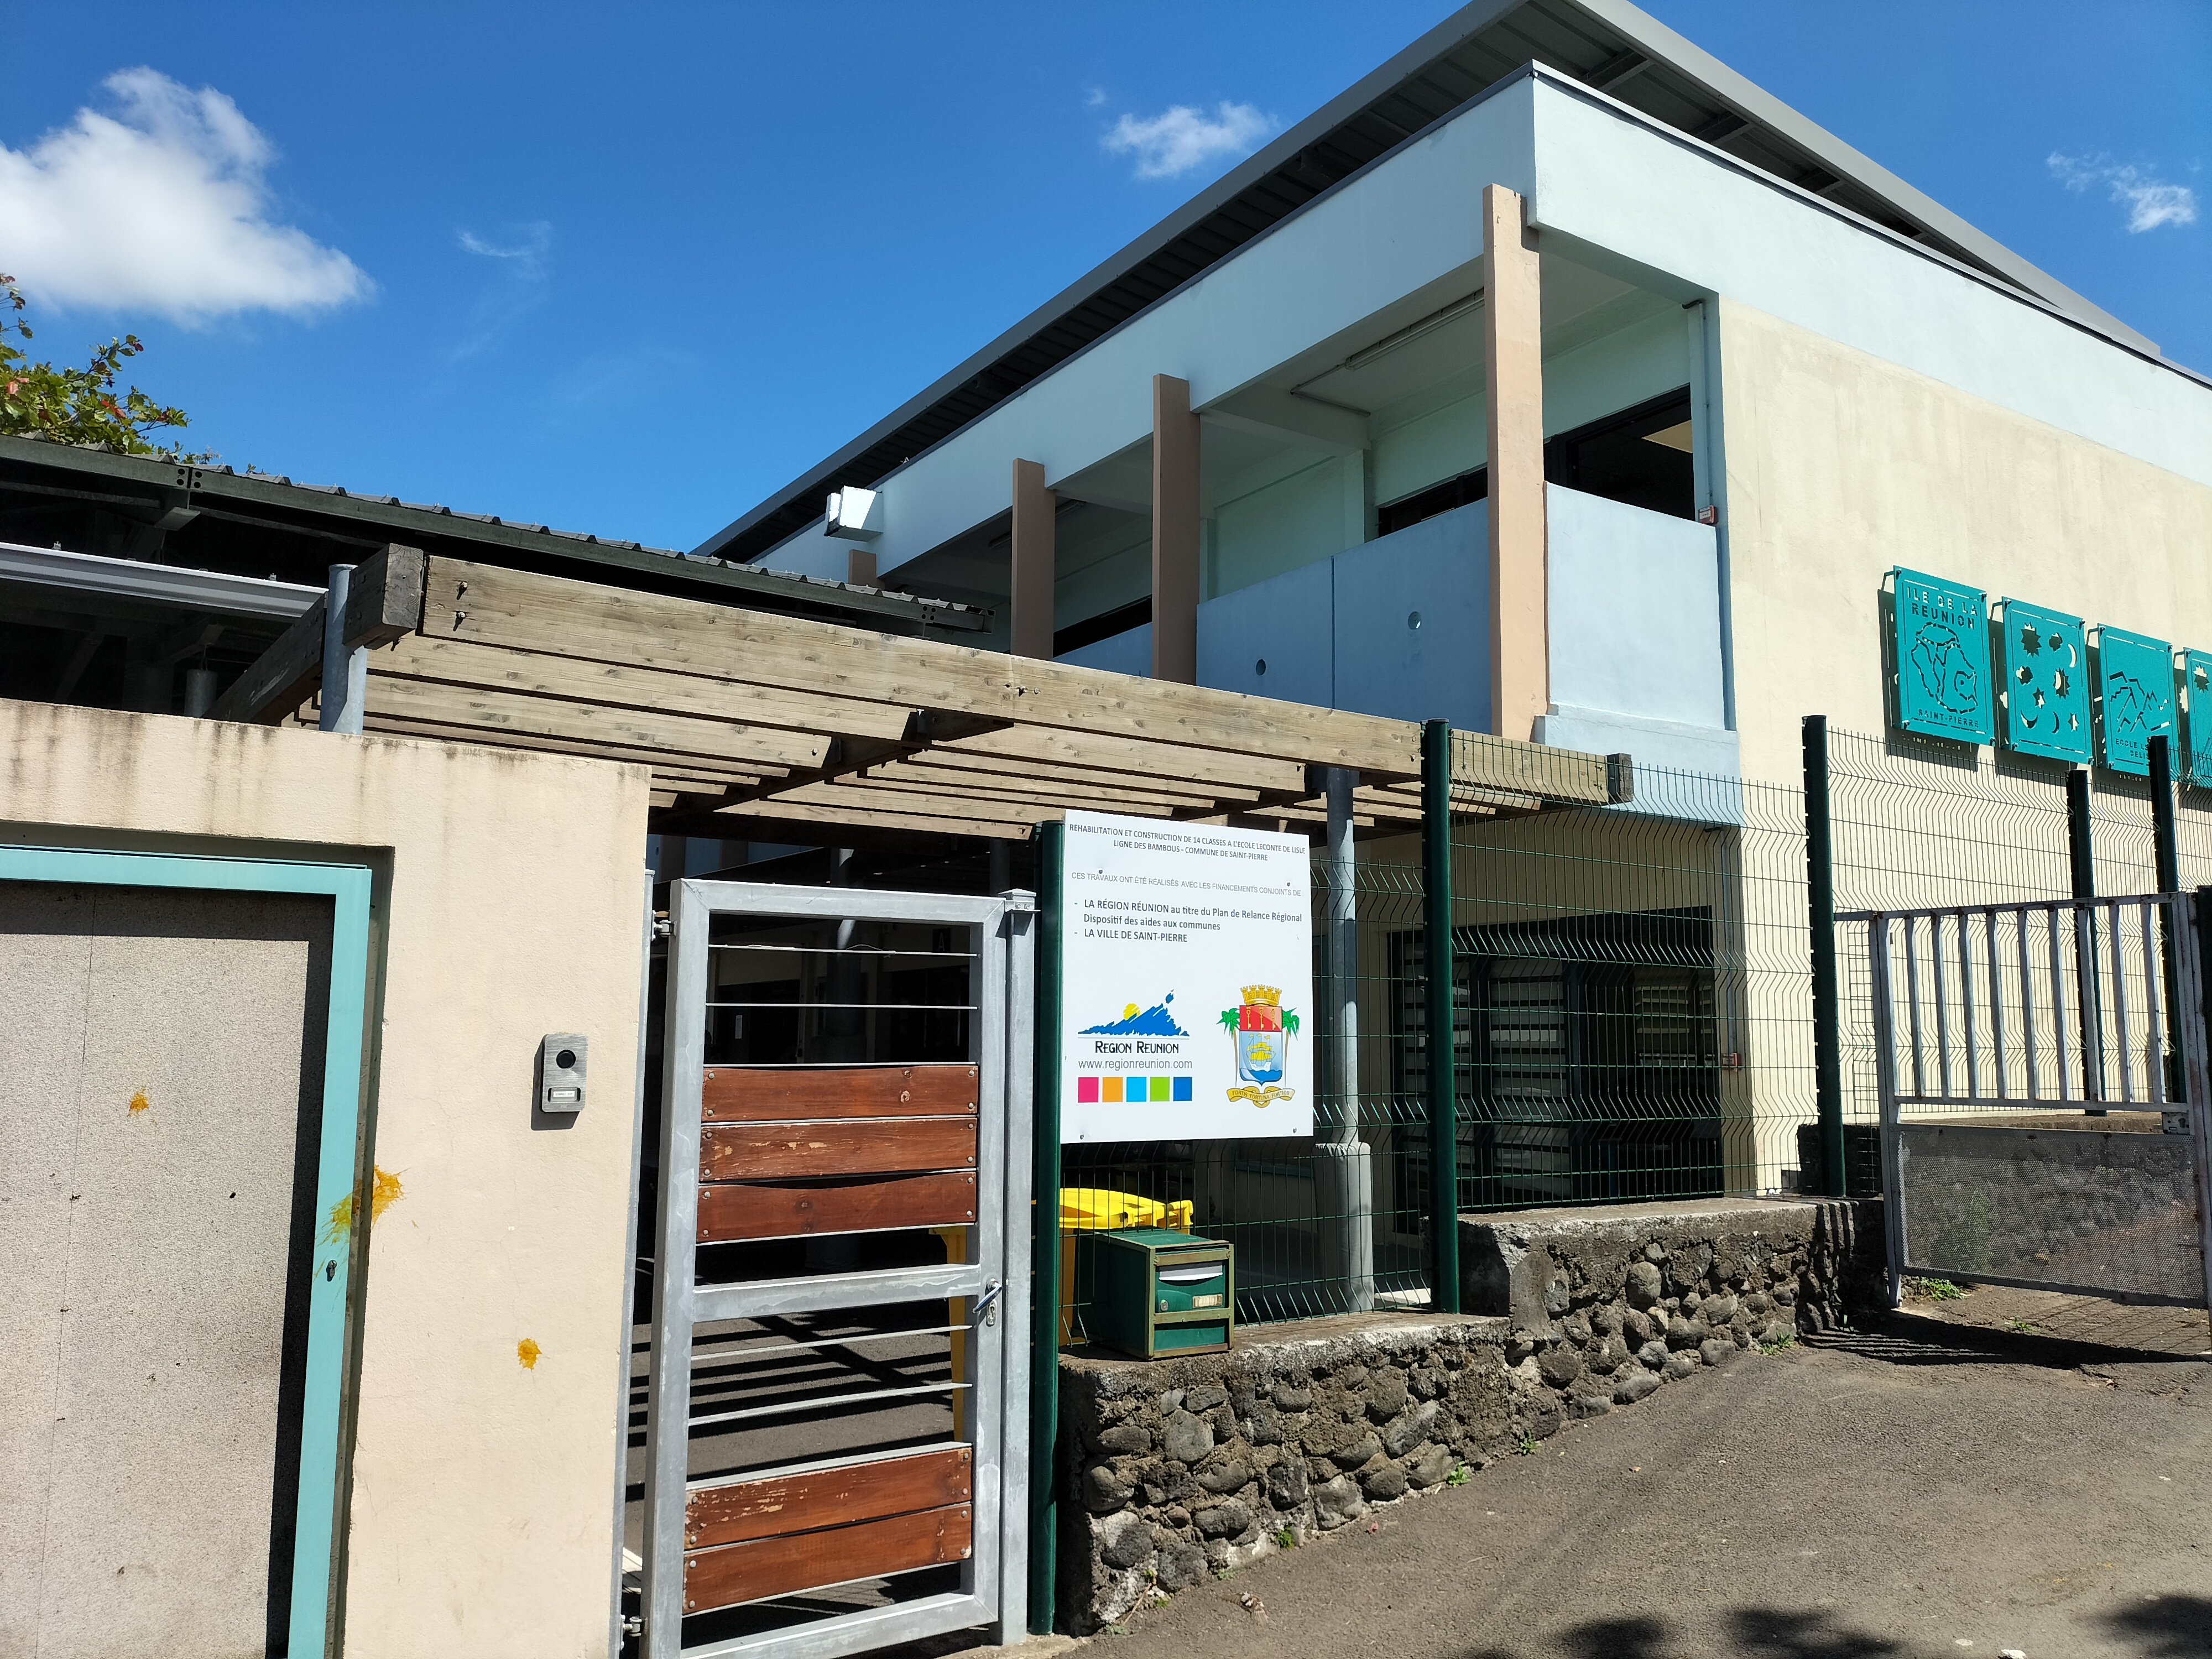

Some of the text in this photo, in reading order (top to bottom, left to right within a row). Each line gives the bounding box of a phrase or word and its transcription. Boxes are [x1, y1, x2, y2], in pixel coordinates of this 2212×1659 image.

[1907, 586, 1978, 616] ILE DE LA
[1912, 602, 1974, 630] REUNION
[1918, 708, 1979, 728] SAINT-PIERRE
[2115, 738, 2137, 748] ECOLE
[1070, 823, 1123, 836] REHABILITATION
[1134, 830, 1182, 842] CONSTRUCTION
[1202, 837, 1226, 846] CLASSES
[1233, 841, 1255, 849] L'ECOLE
[1256, 843, 1282, 851] LECONTE
[1114, 839, 1133, 848] LIGNE
[1147, 843, 1180, 852] BAMBOUS
[1185, 847, 1219, 856] COMMUNE
[1229, 851, 1269, 860] SAINT-PIERRE
[1087, 873, 1118, 883] TRAVAUX
[1134, 875, 1147, 884] ÉTÉ
[1148, 877, 1179, 886] RÉALISÉS
[1212, 883, 1258, 893] FINANCEMENTS
[1259, 887, 1292, 896] CONJOINTS
[1084, 899, 1095, 908] LA
[1097, 898, 1129, 910] RÉGION
[1131, 900, 1169, 912] RÉUNION
[1182, 905, 1199, 915] titre
[1201, 906, 1211, 915] du
[1212, 907, 1229, 917] Plan
[1230, 909, 1240, 917] de
[1241, 910, 1270, 920] Relance
[1271, 911, 1302, 922] Régional
[1083, 914, 1123, 925] Dispositif
[1124, 916, 1139, 925] des
[1140, 917, 1161, 926] aides
[1178, 921, 1220, 930] communes
[1084, 928, 1095, 937] LA
[1096, 928, 1119, 938] VILLE
[1121, 930, 1132, 939] DE
[1133, 931, 1188, 942] SAINT-PIERRE
[1095, 1040, 1179, 1053] REGION REUNION
[1078, 1058, 1193, 1071] www.regionreunion.com
